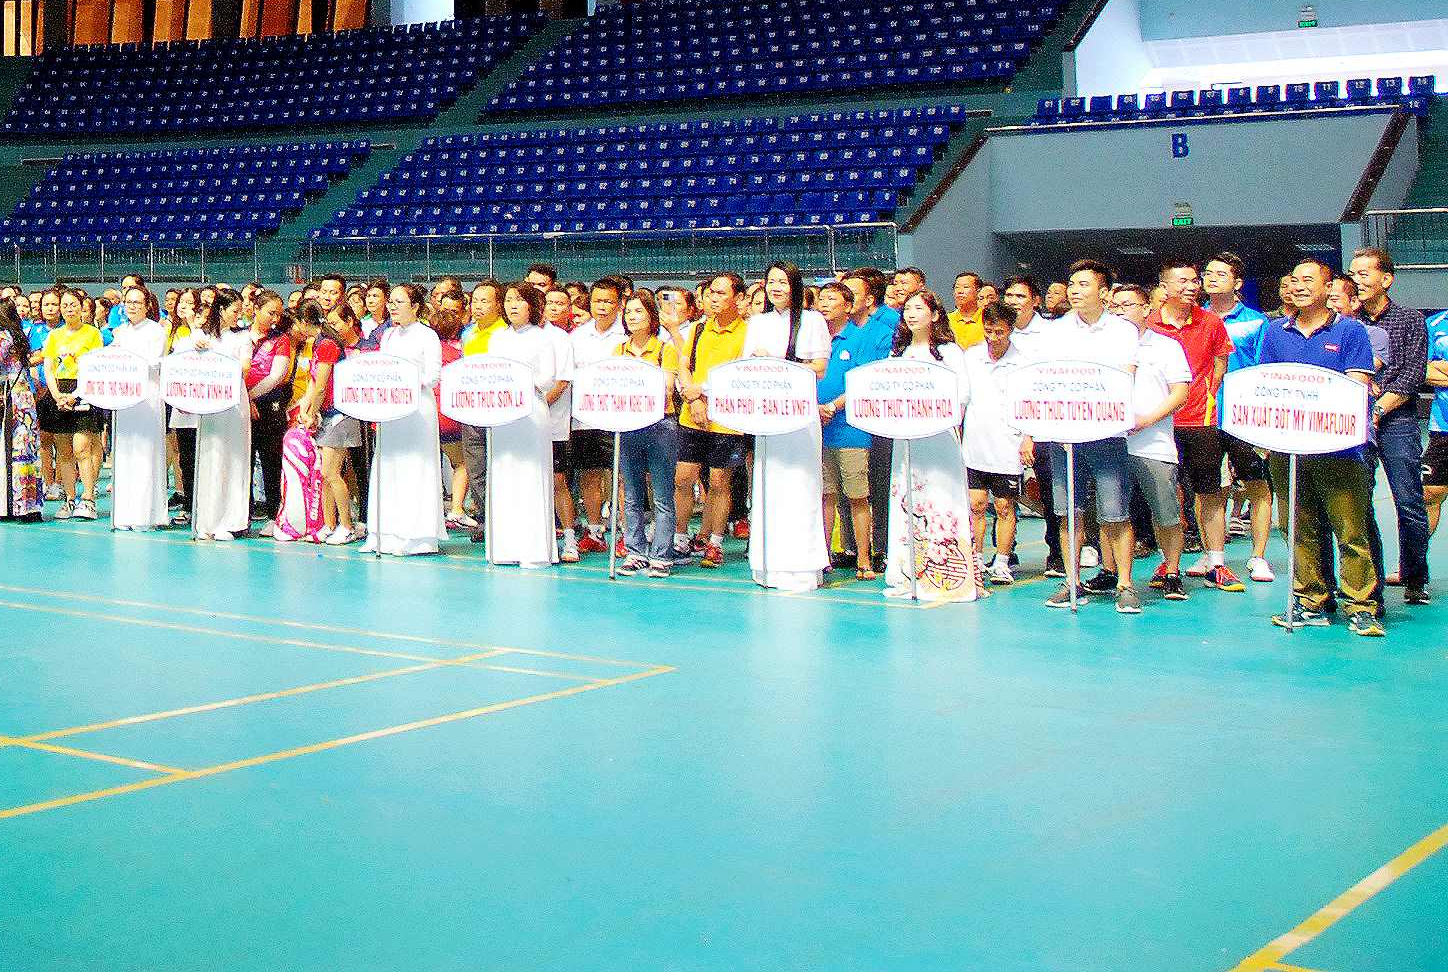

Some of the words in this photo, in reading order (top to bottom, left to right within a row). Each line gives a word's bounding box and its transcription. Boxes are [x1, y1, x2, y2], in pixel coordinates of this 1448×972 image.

[1171, 133, 1191, 158] B
[731, 377, 751, 390] CÔNG
[752, 380, 761, 389] TY
[870, 379, 891, 391] CÔNG
[892, 381, 901, 391] TY
[1032, 379, 1055, 392] CÔNG
[1057, 382, 1067, 392] TY
[451, 390, 475, 408] LƯƠNG
[515, 390, 525, 408] LA
[1254, 384, 1280, 398] CÔNG
[1282, 388, 1292, 398] TY
[1295, 389, 1319, 401] TNHH
[791, 399, 811, 416] VNF1
[853, 397, 881, 418] LƯƠNG
[906, 398, 934, 419] THANH
[1014, 399, 1041, 421] LƯƠNG
[1067, 396, 1093, 421] TUYÊN
[1095, 401, 1125, 423] QUANG
[1308, 410, 1357, 437] VIMAFLOUR
